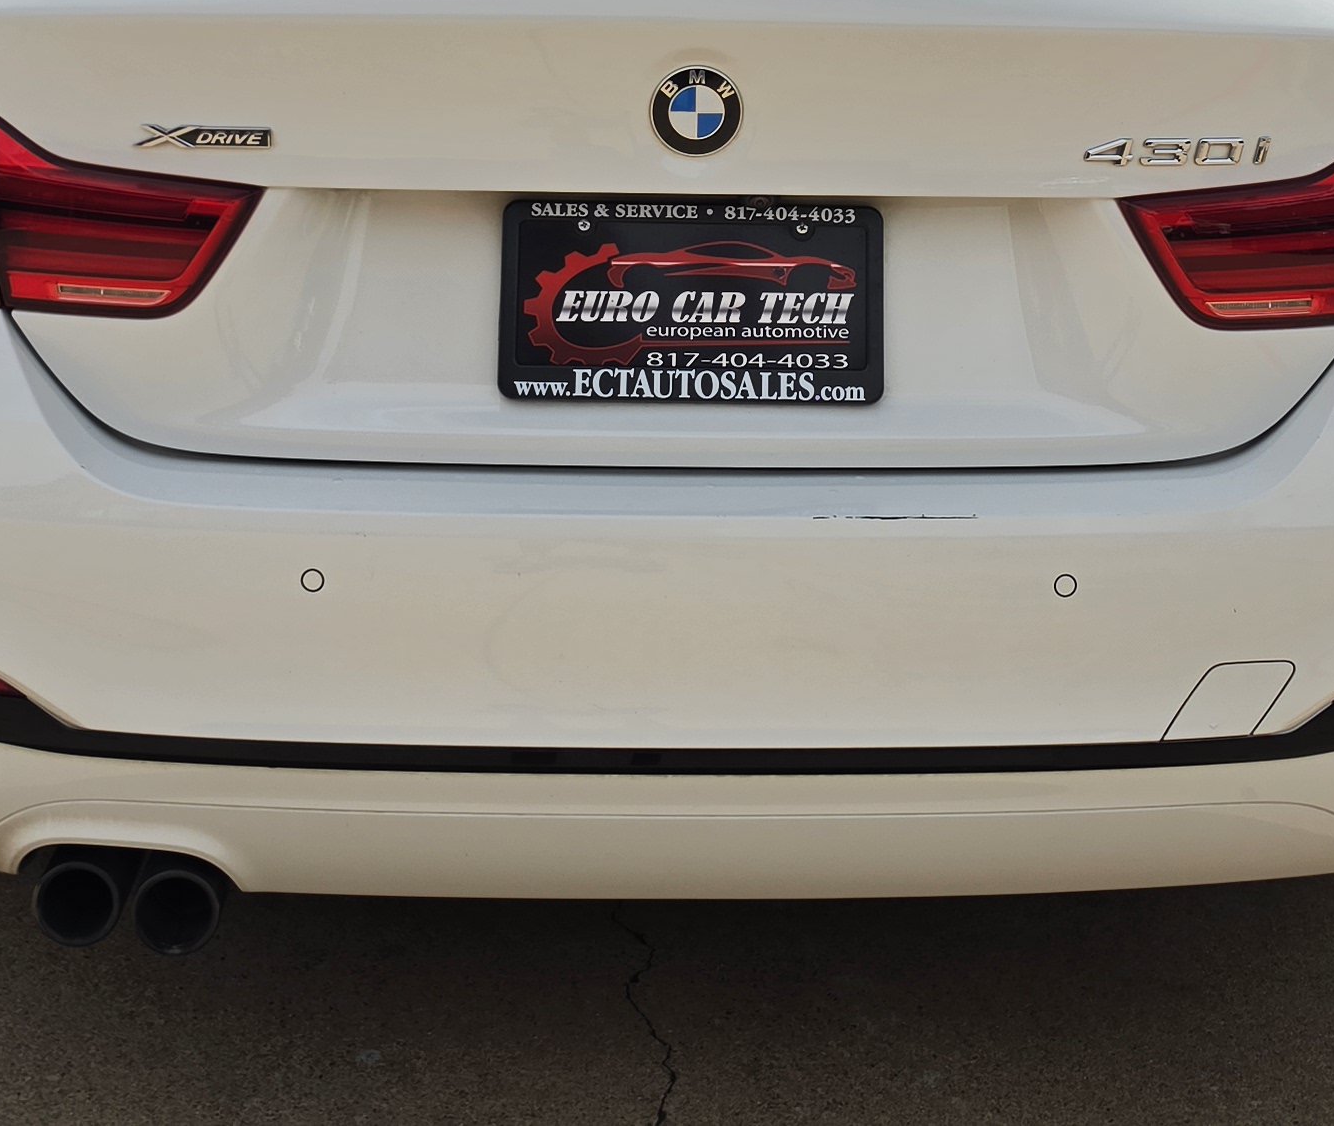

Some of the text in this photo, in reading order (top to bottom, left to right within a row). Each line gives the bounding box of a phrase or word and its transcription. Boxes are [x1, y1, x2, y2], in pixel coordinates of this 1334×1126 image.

[660, 69, 736, 99] BMW
[1083, 136, 1272, 166] 430i
[531, 202, 856, 224] SALES & SERVICE 817-404-4033
[556, 290, 855, 325] EURO CAR TECH
[646, 325, 850, 341] european automotive
[646, 352, 849, 369] 817-404-4033
[513, 368, 866, 402] www.ECTAUTOSALES.com
